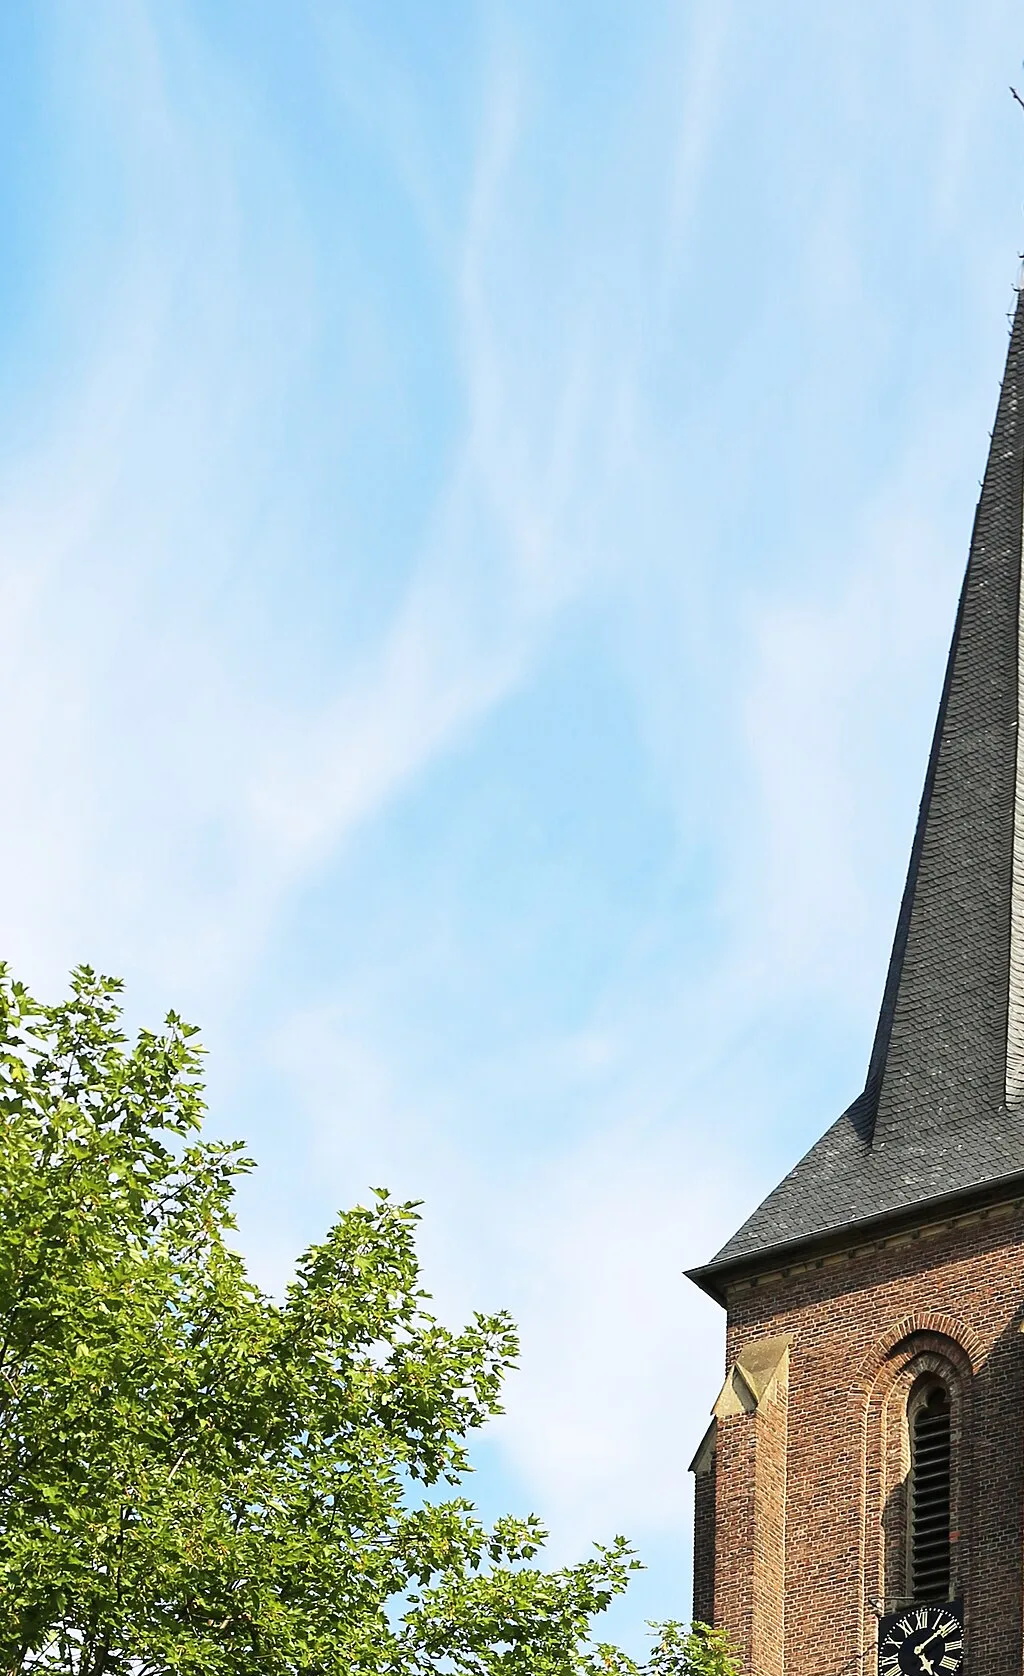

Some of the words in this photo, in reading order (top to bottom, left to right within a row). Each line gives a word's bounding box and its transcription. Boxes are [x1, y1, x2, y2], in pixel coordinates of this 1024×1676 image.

[896, 1618, 914, 1638] XI
[915, 1611, 928, 1630] XII
[932, 1612, 943, 1630] I
[886, 1637, 904, 1649] X
[944, 1640, 962, 1652] III
[879, 1653, 899, 1666] IX
